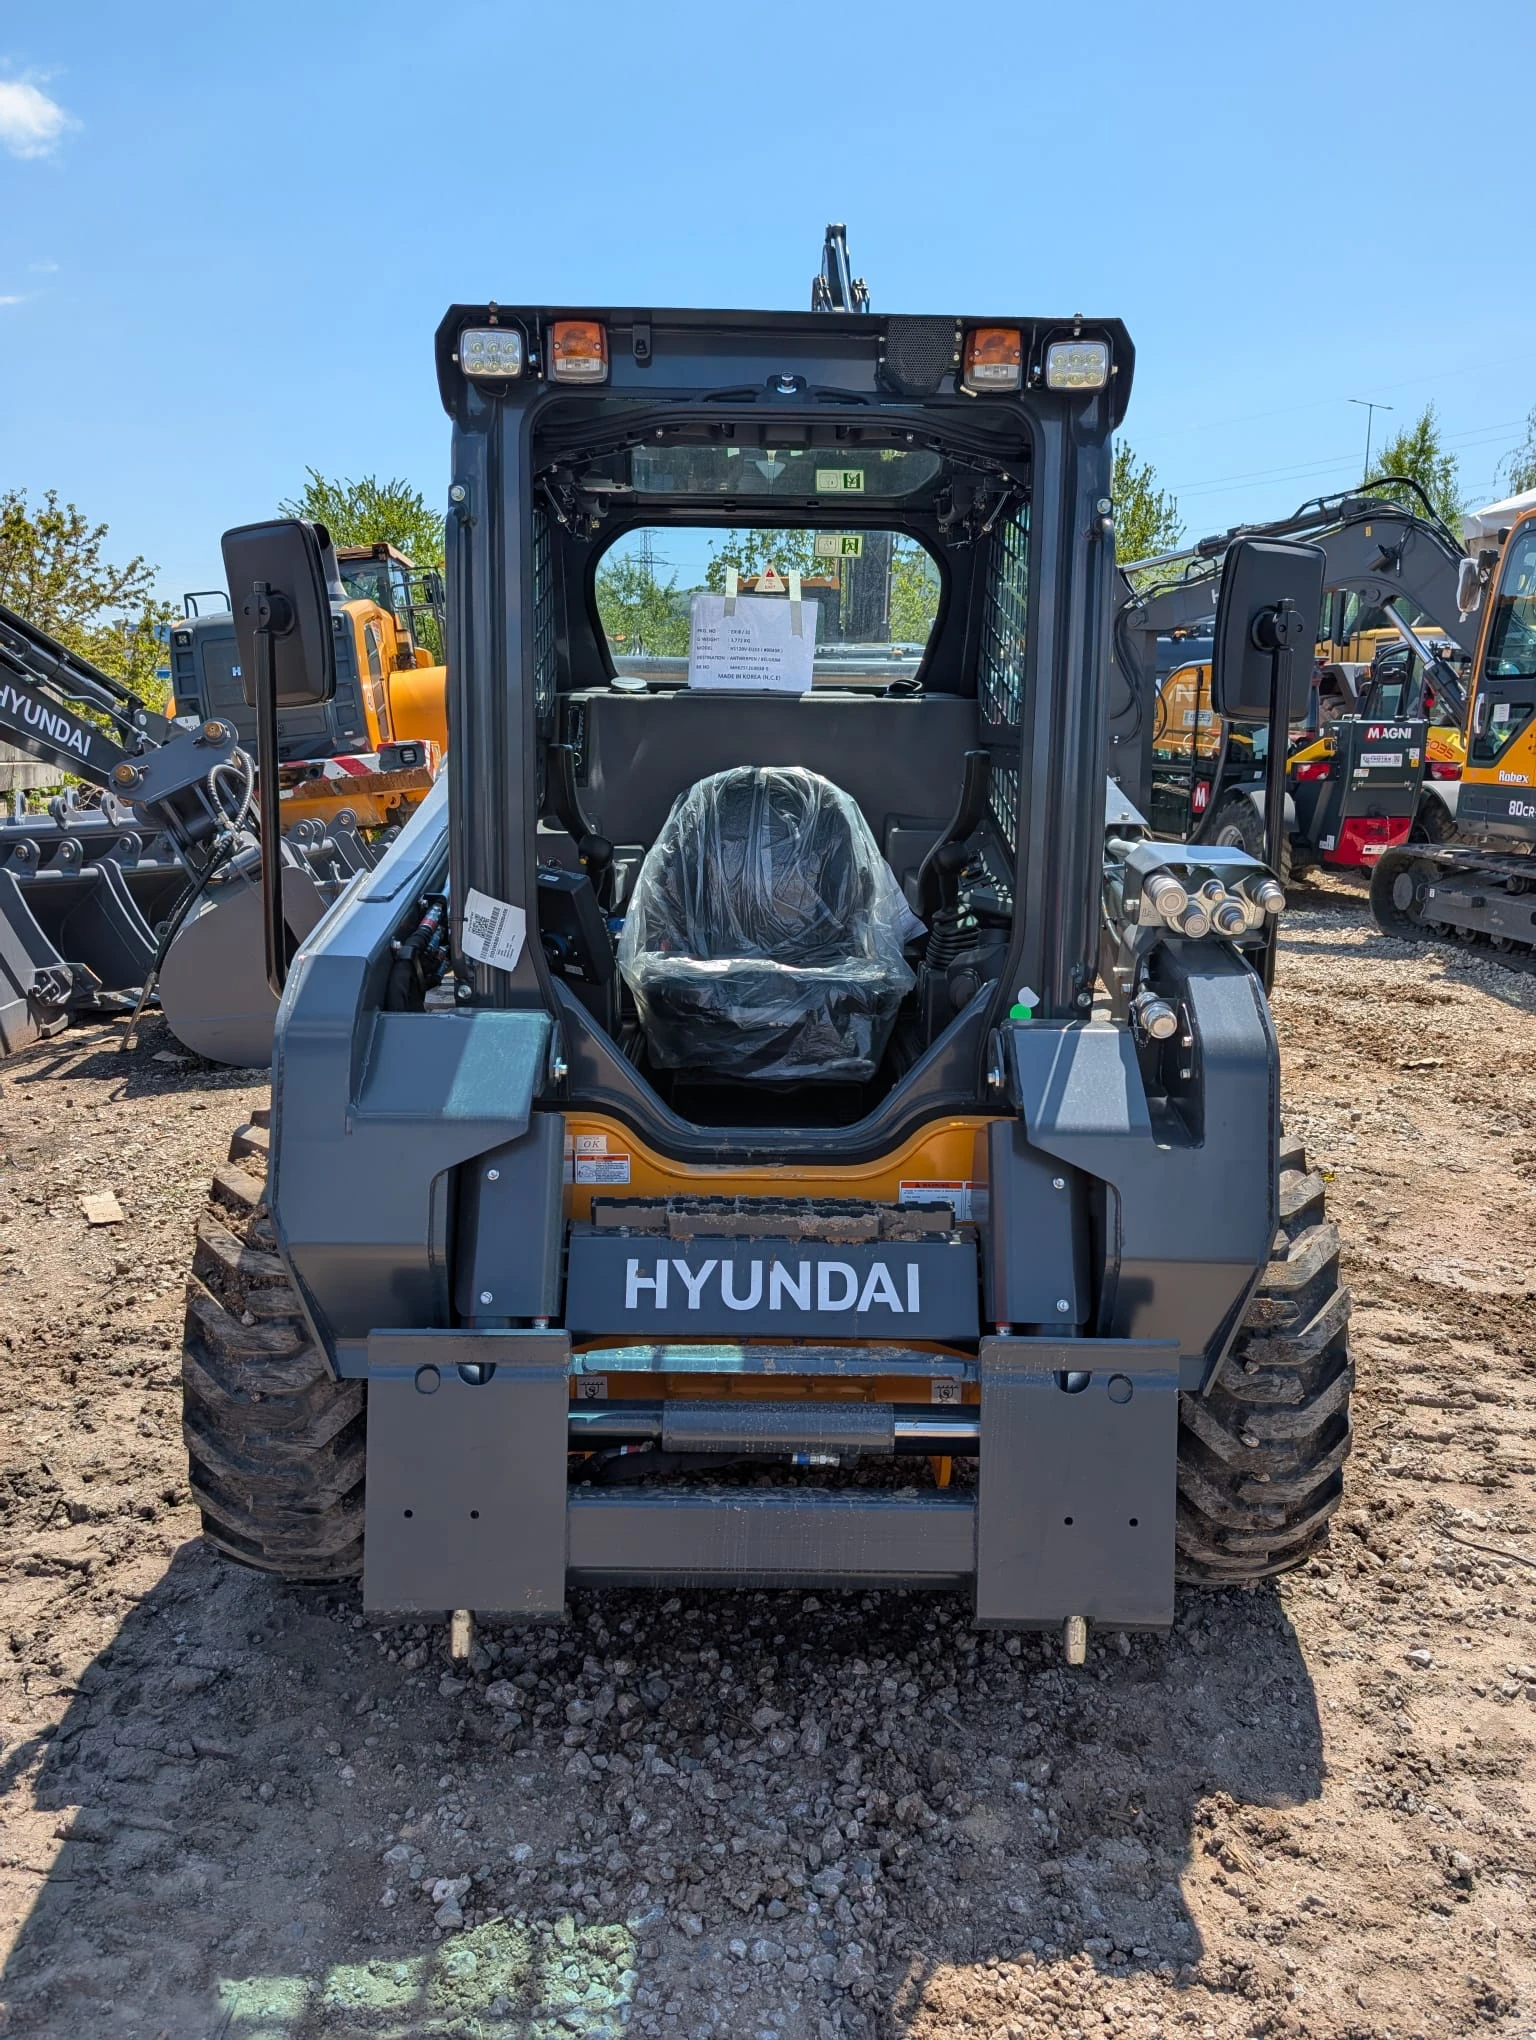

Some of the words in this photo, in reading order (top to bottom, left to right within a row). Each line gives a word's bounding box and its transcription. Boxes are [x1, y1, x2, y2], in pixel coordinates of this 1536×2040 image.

[1367, 727, 1412, 740] MAGNI
[1427, 738, 1455, 760] 035
[1498, 770, 1529, 783] Robex
[624, 1258, 920, 1313] HYUNDAI
